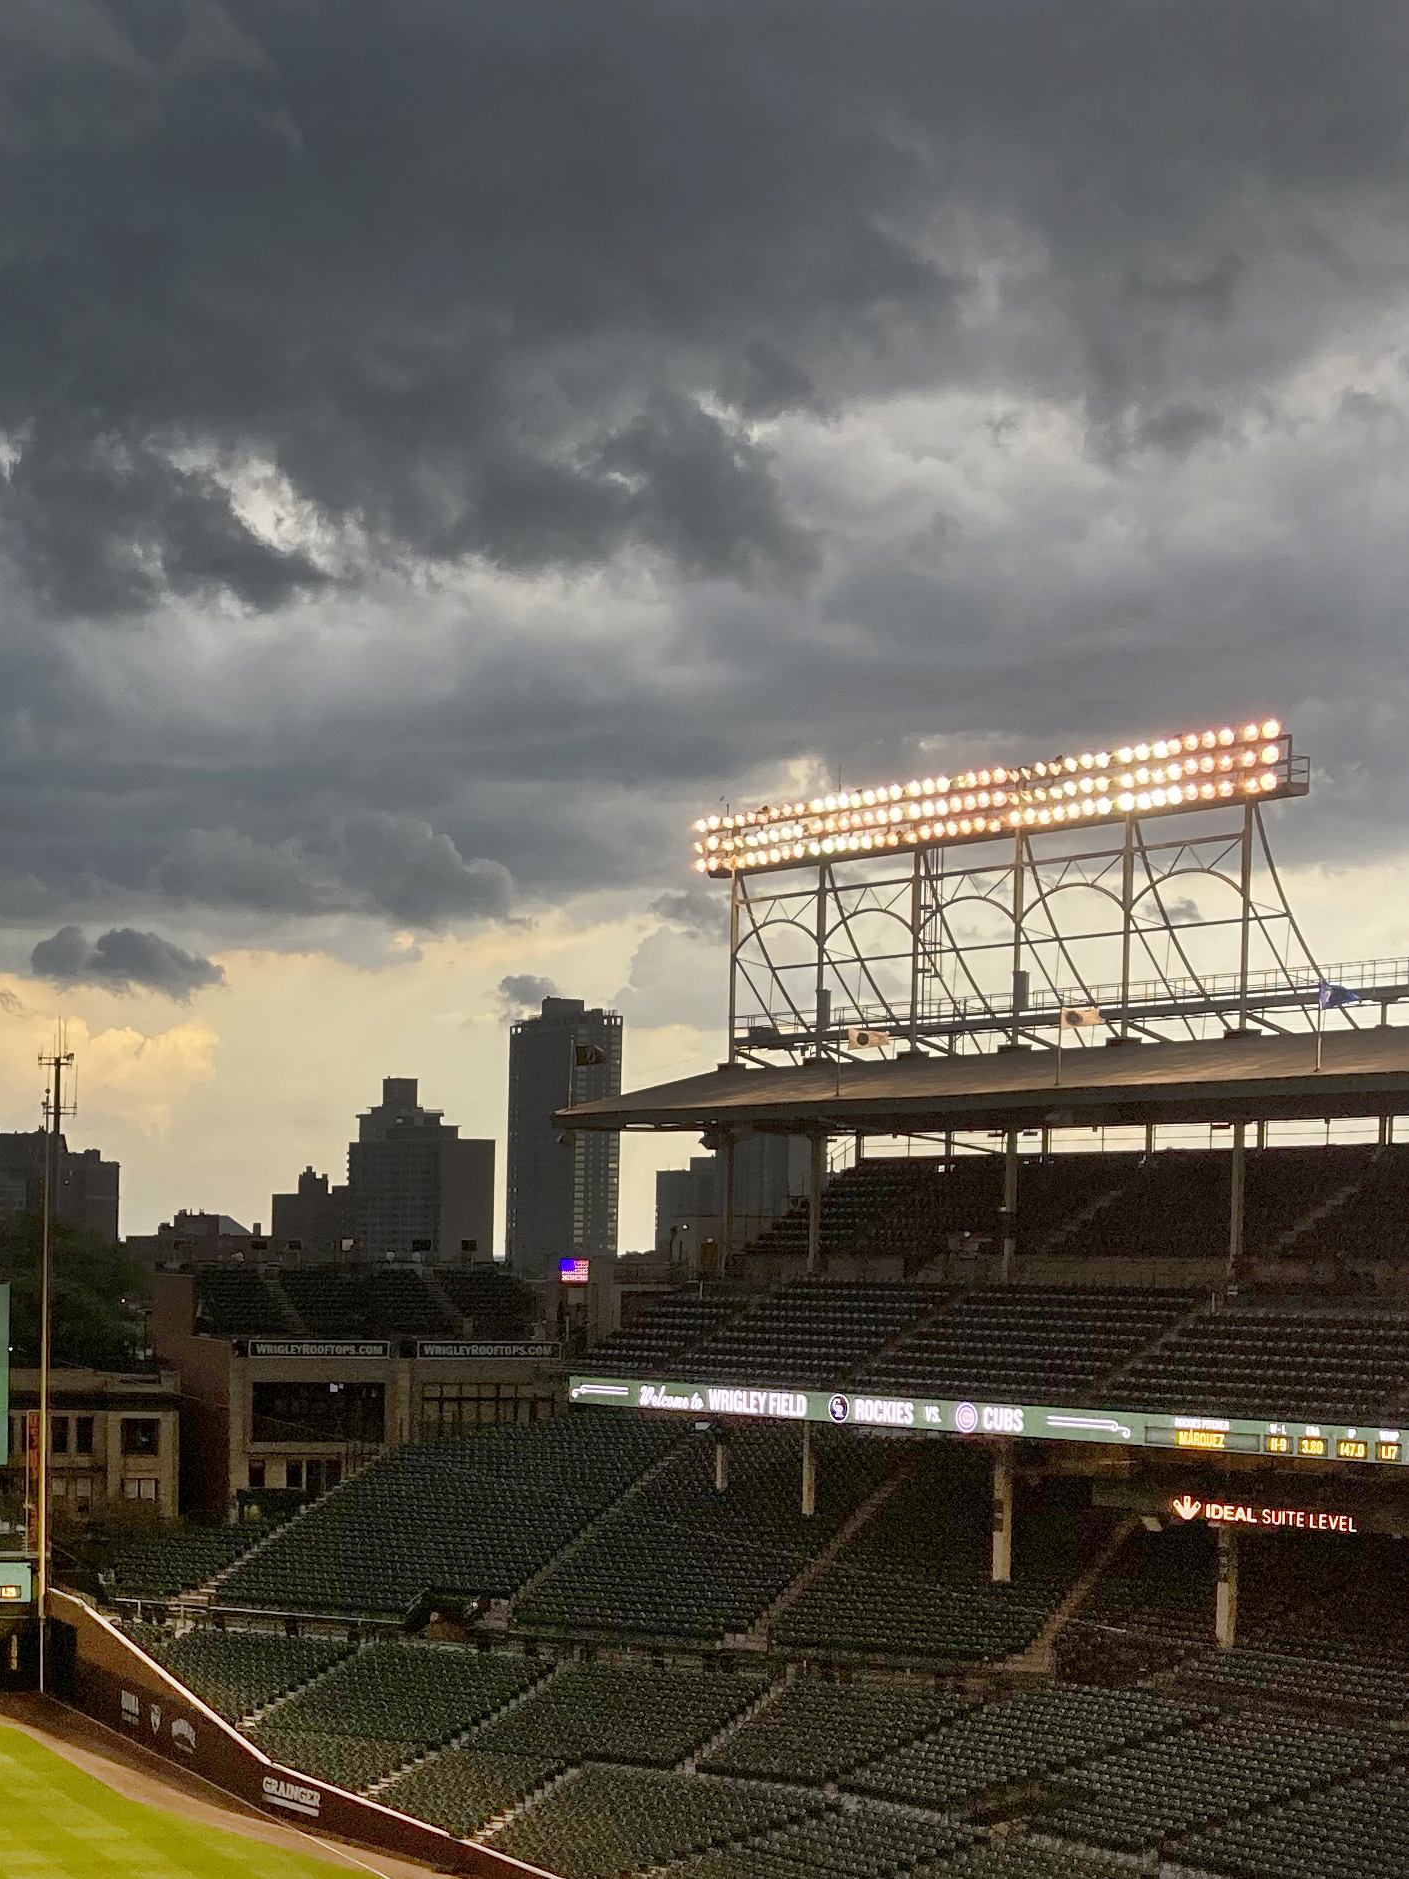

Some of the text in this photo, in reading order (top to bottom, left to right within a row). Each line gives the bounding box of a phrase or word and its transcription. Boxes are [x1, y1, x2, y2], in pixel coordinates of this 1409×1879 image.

[638, 1384, 705, 1411] Welcome to
[707, 1388, 808, 1418] WRIGLEY FIELD
[854, 1399, 914, 1425] ROCKIES
[924, 1405, 942, 1423] VS.
[982, 1406, 1025, 1432] CUBS
[1178, 1429, 1226, 1448] MÁRQUEZ
[1306, 1425, 1321, 1437] ERA
[1301, 1439, 1325, 1455] 3.80
[1340, 1442, 1365, 1458] 147.0
[1205, 1503, 1358, 1533] IDEAL SUITE LEVEL
[262, 1775, 321, 1808] GRAINGER
